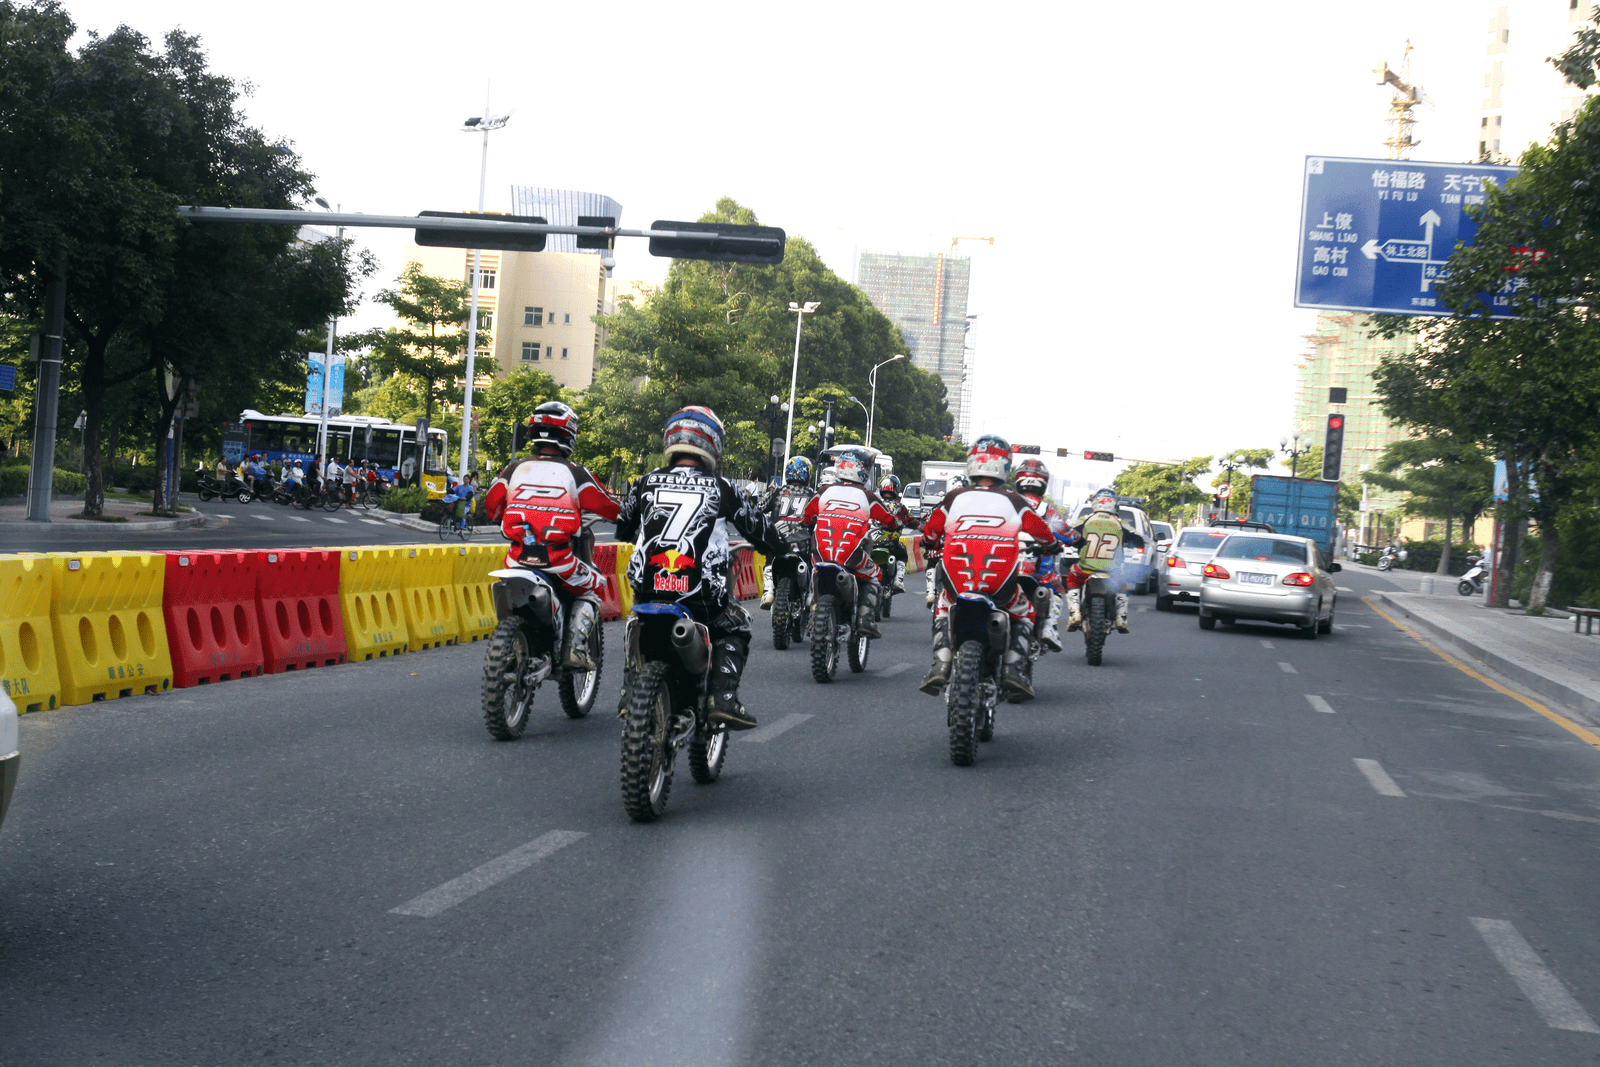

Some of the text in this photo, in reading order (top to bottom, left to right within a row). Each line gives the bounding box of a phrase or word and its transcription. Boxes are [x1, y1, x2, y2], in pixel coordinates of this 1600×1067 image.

[1371, 169, 1426, 190] 怡福路
[1378, 190, 1418, 202] YI FU LU
[1440, 193, 1461, 204] TIAN
[1308, 230, 1358, 243] SHANG LIAO
[1313, 245, 1349, 264] 高村
[1312, 265, 1349, 277] GAO CUN
[649, 474, 715, 487] STEWART
[779, 495, 809, 517] 14
[653, 488, 706, 545] 7
[1085, 532, 1120, 560] 12
[653, 572, 689, 592] Red Bull
